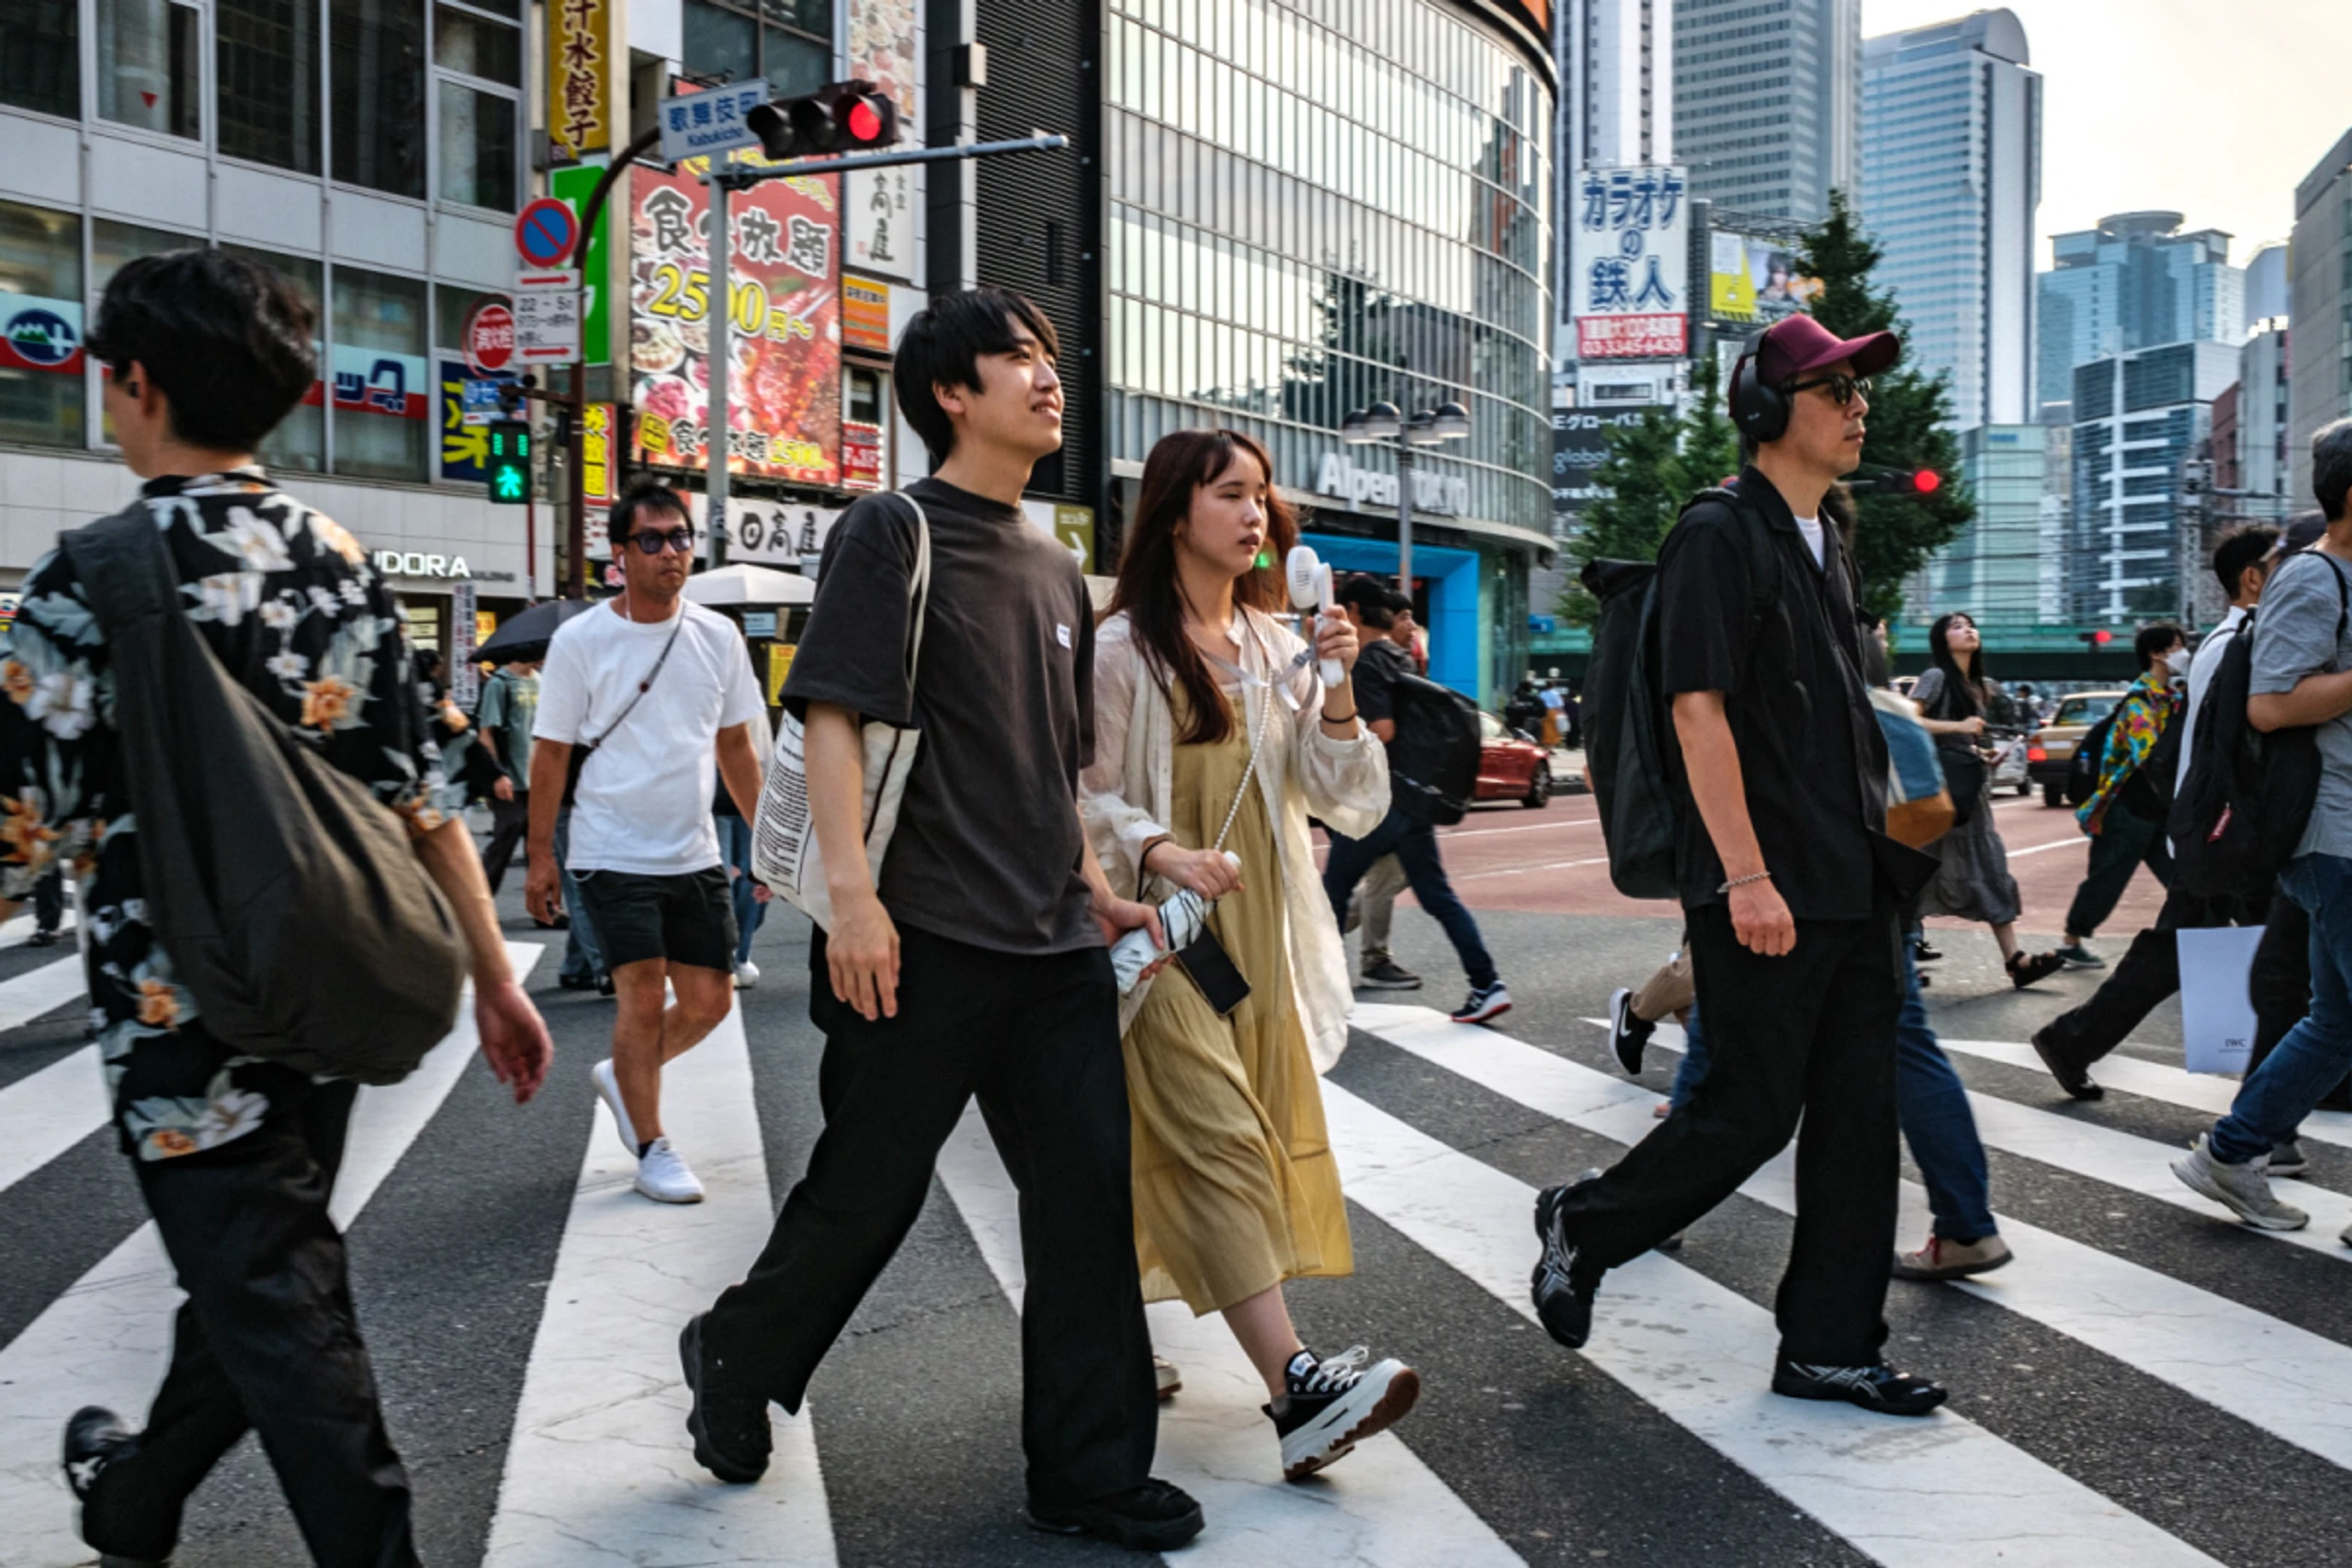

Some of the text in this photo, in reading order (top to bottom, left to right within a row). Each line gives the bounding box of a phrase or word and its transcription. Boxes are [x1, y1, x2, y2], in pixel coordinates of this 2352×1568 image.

[869, 171, 895, 263] 高屋
[1583, 171, 1683, 229] カラオケ
[1621, 228, 1643, 258] の
[1590, 257, 1674, 309] 鉄人
[1317, 452, 1401, 513] Alpen
